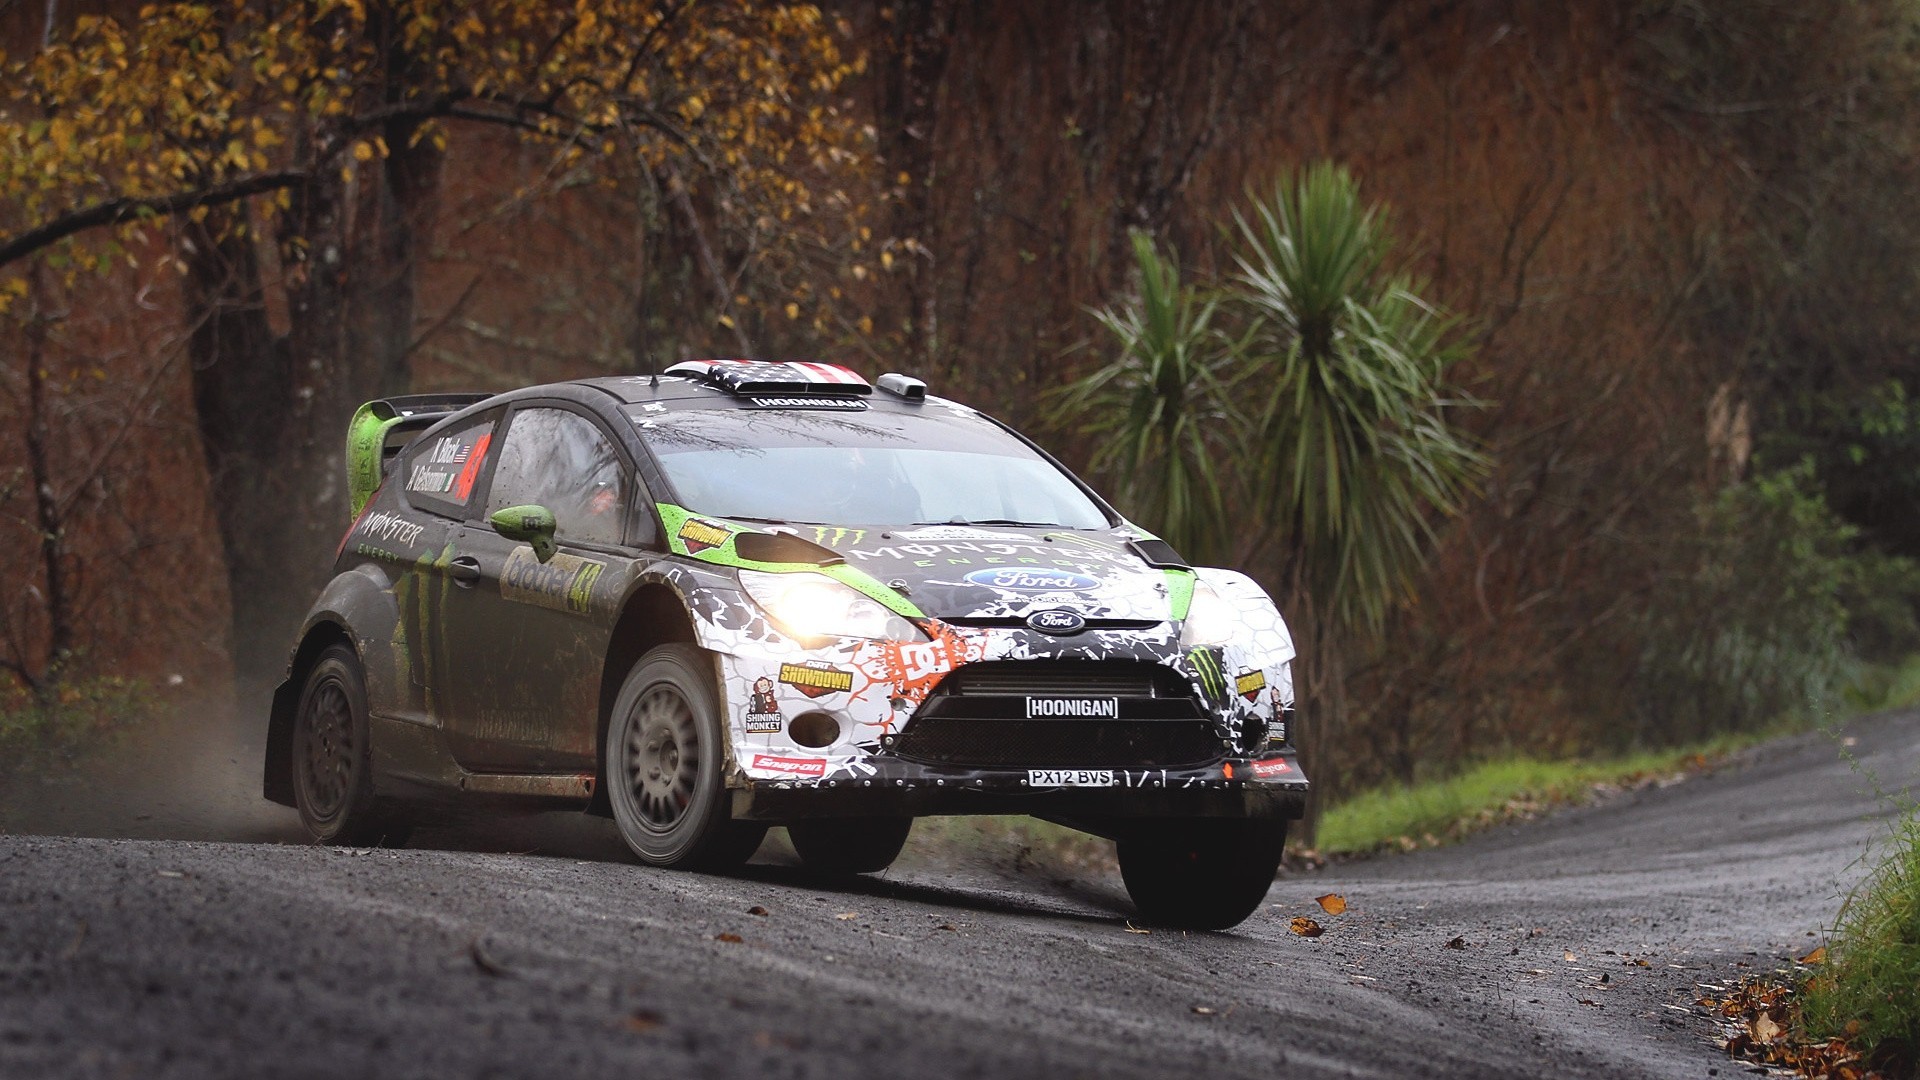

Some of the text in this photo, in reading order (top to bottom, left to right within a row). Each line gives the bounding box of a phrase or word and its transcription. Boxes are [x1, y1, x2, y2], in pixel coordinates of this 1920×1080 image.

[430, 437, 460, 464] K Block
[405, 465, 419, 491] A
[358, 543, 400, 562] ENERGY
[913, 557, 1102, 570] ENERGY
[993, 569, 1079, 588] Ford
[1040, 613, 1073, 626] Ford
[900, 639, 951, 681] DC
[1026, 697, 1119, 719] [HOONIGAN]
[746, 713, 780, 722] SHINING
[746, 722, 780, 731] MONKEY
[755, 758, 823, 772] Snap-on
[1032, 771, 1110, 784] PX12 BVS
